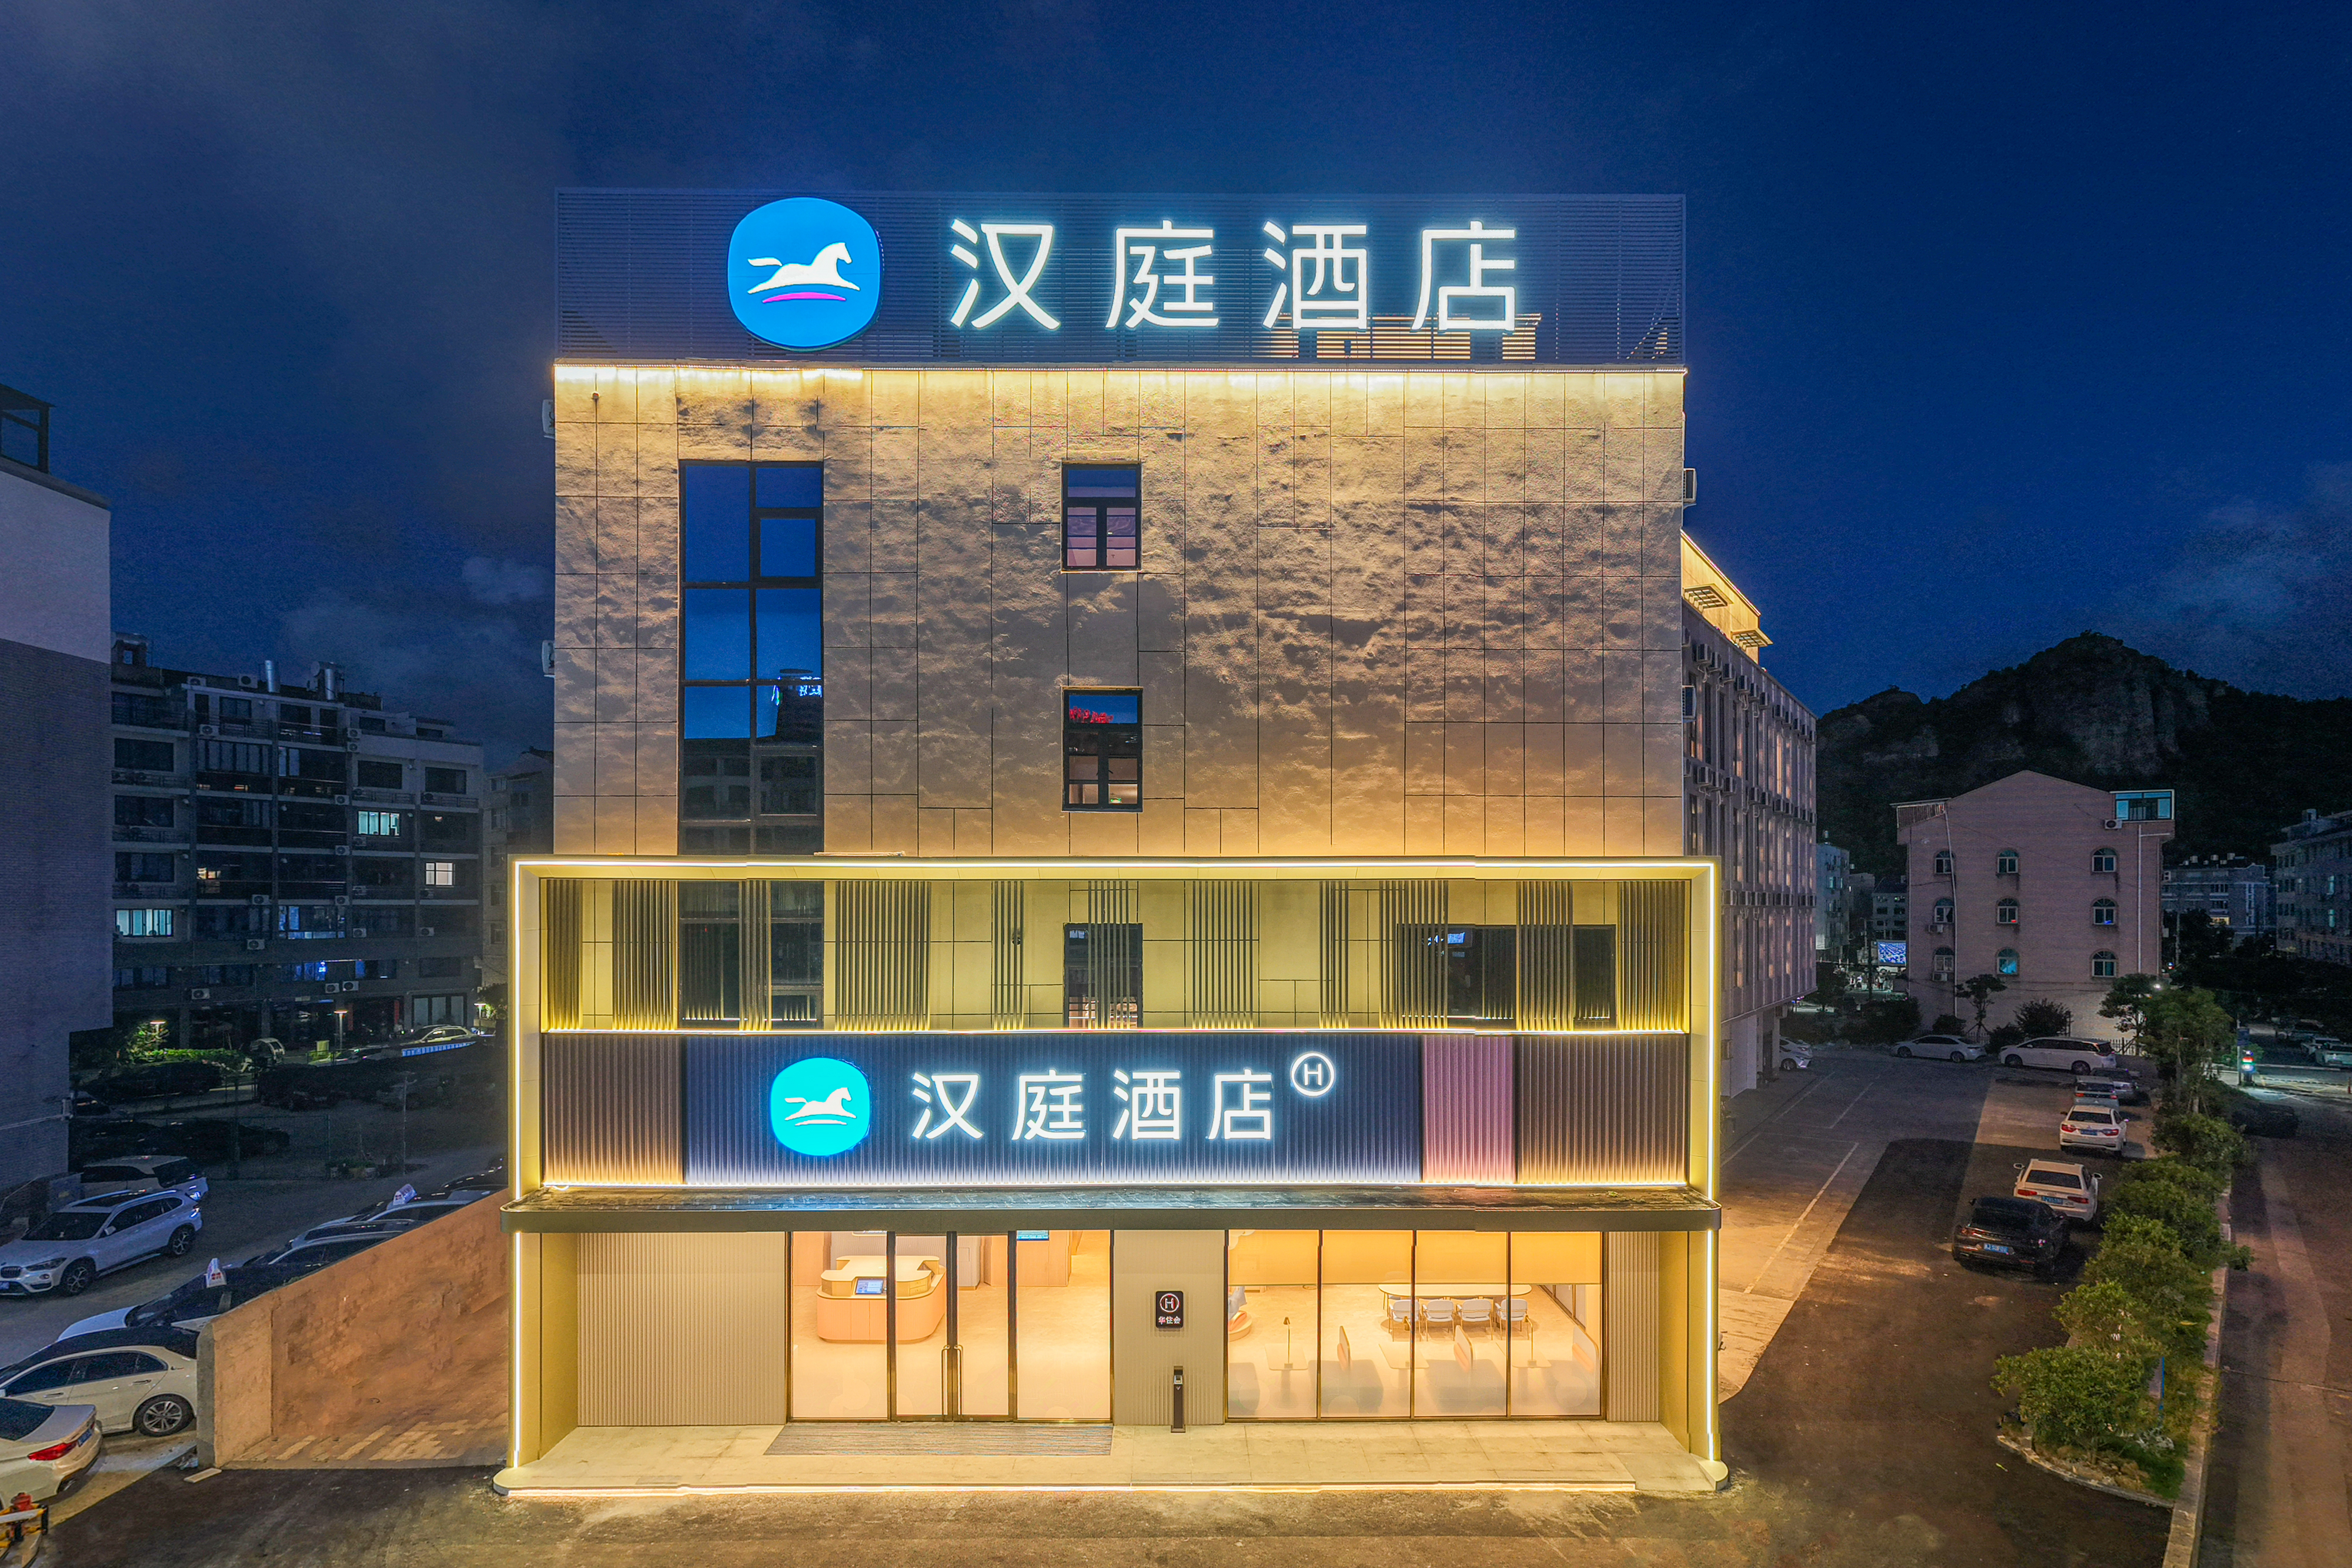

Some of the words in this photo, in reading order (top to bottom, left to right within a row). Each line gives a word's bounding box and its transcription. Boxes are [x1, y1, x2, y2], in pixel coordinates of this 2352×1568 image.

[948, 218, 1517, 331] 汉庭酒店
[910, 1068, 1273, 1141] 汉庭酒店
[1158, 1316, 1181, 1325] 华住会
